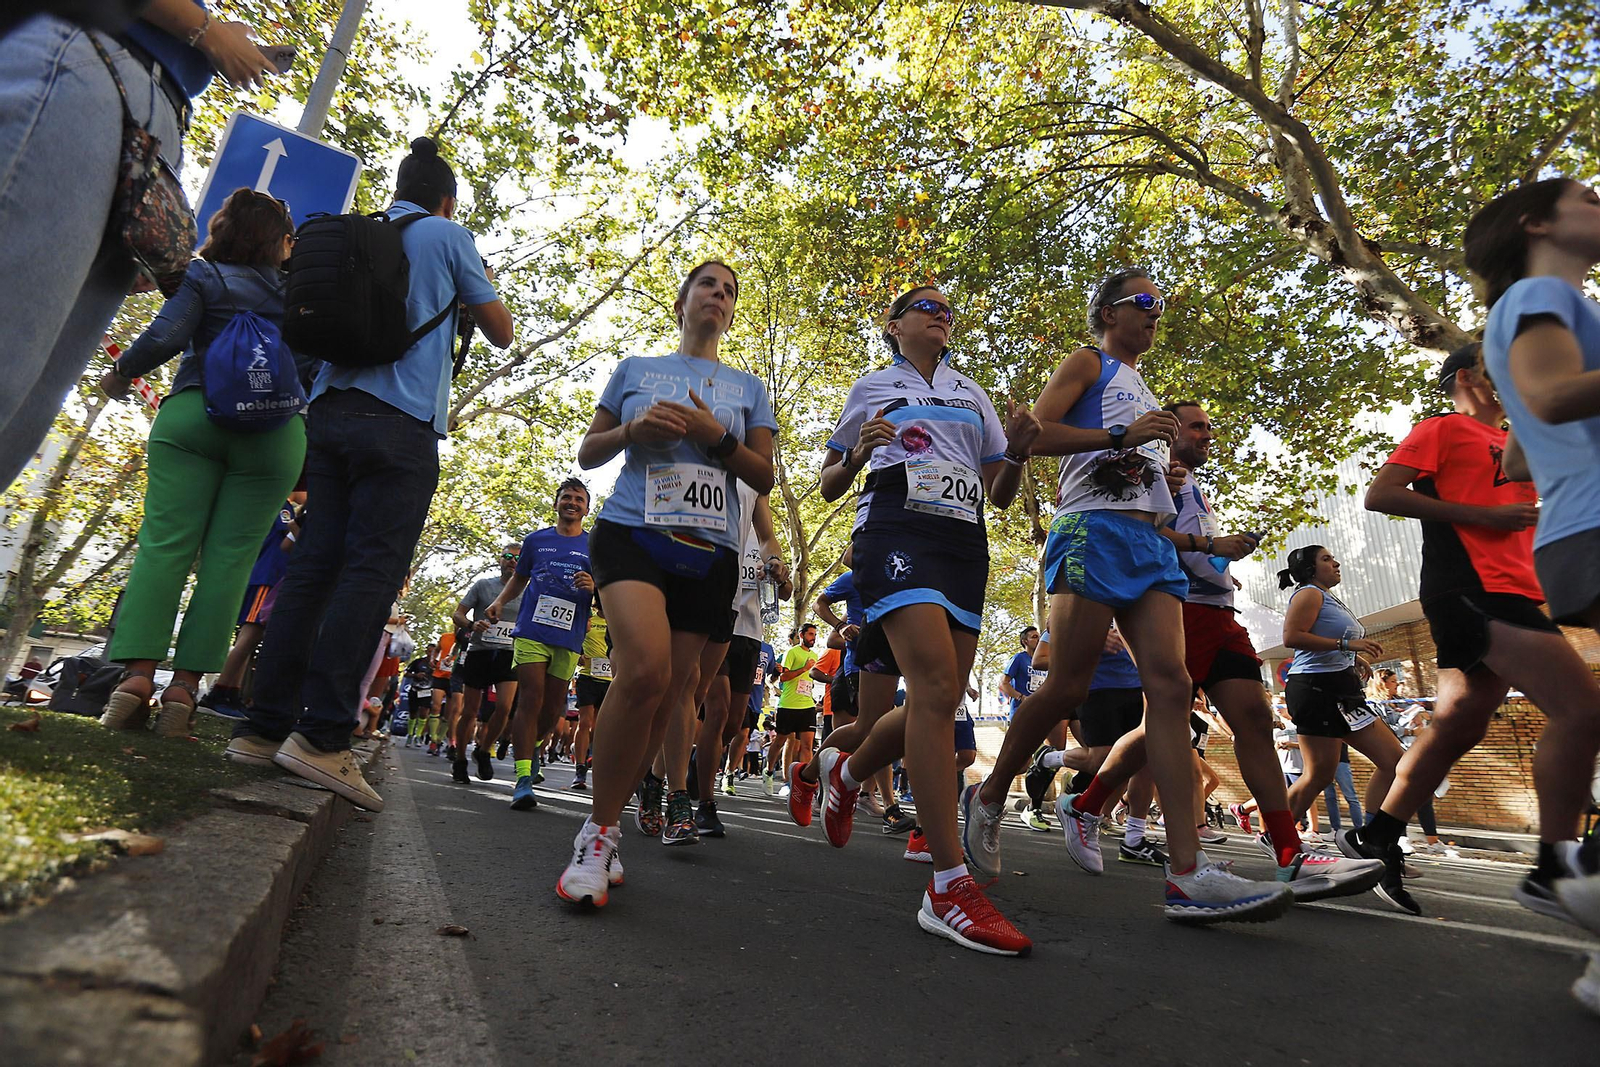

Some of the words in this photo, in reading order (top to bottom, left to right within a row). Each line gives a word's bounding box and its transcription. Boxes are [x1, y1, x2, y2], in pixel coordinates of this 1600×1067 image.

[644, 371, 680, 381] VUELTA
[236, 397, 300, 411] noblemix
[660, 473, 681, 483] VUELTA
[697, 469, 714, 477] ELENA
[662, 481, 682, 490] HUELVA
[941, 475, 979, 507] 204
[683, 481, 723, 512] 400
[550, 561, 582, 570] FORMENTERA
[551, 605, 573, 622] 675
[601, 662, 611, 672] 62
